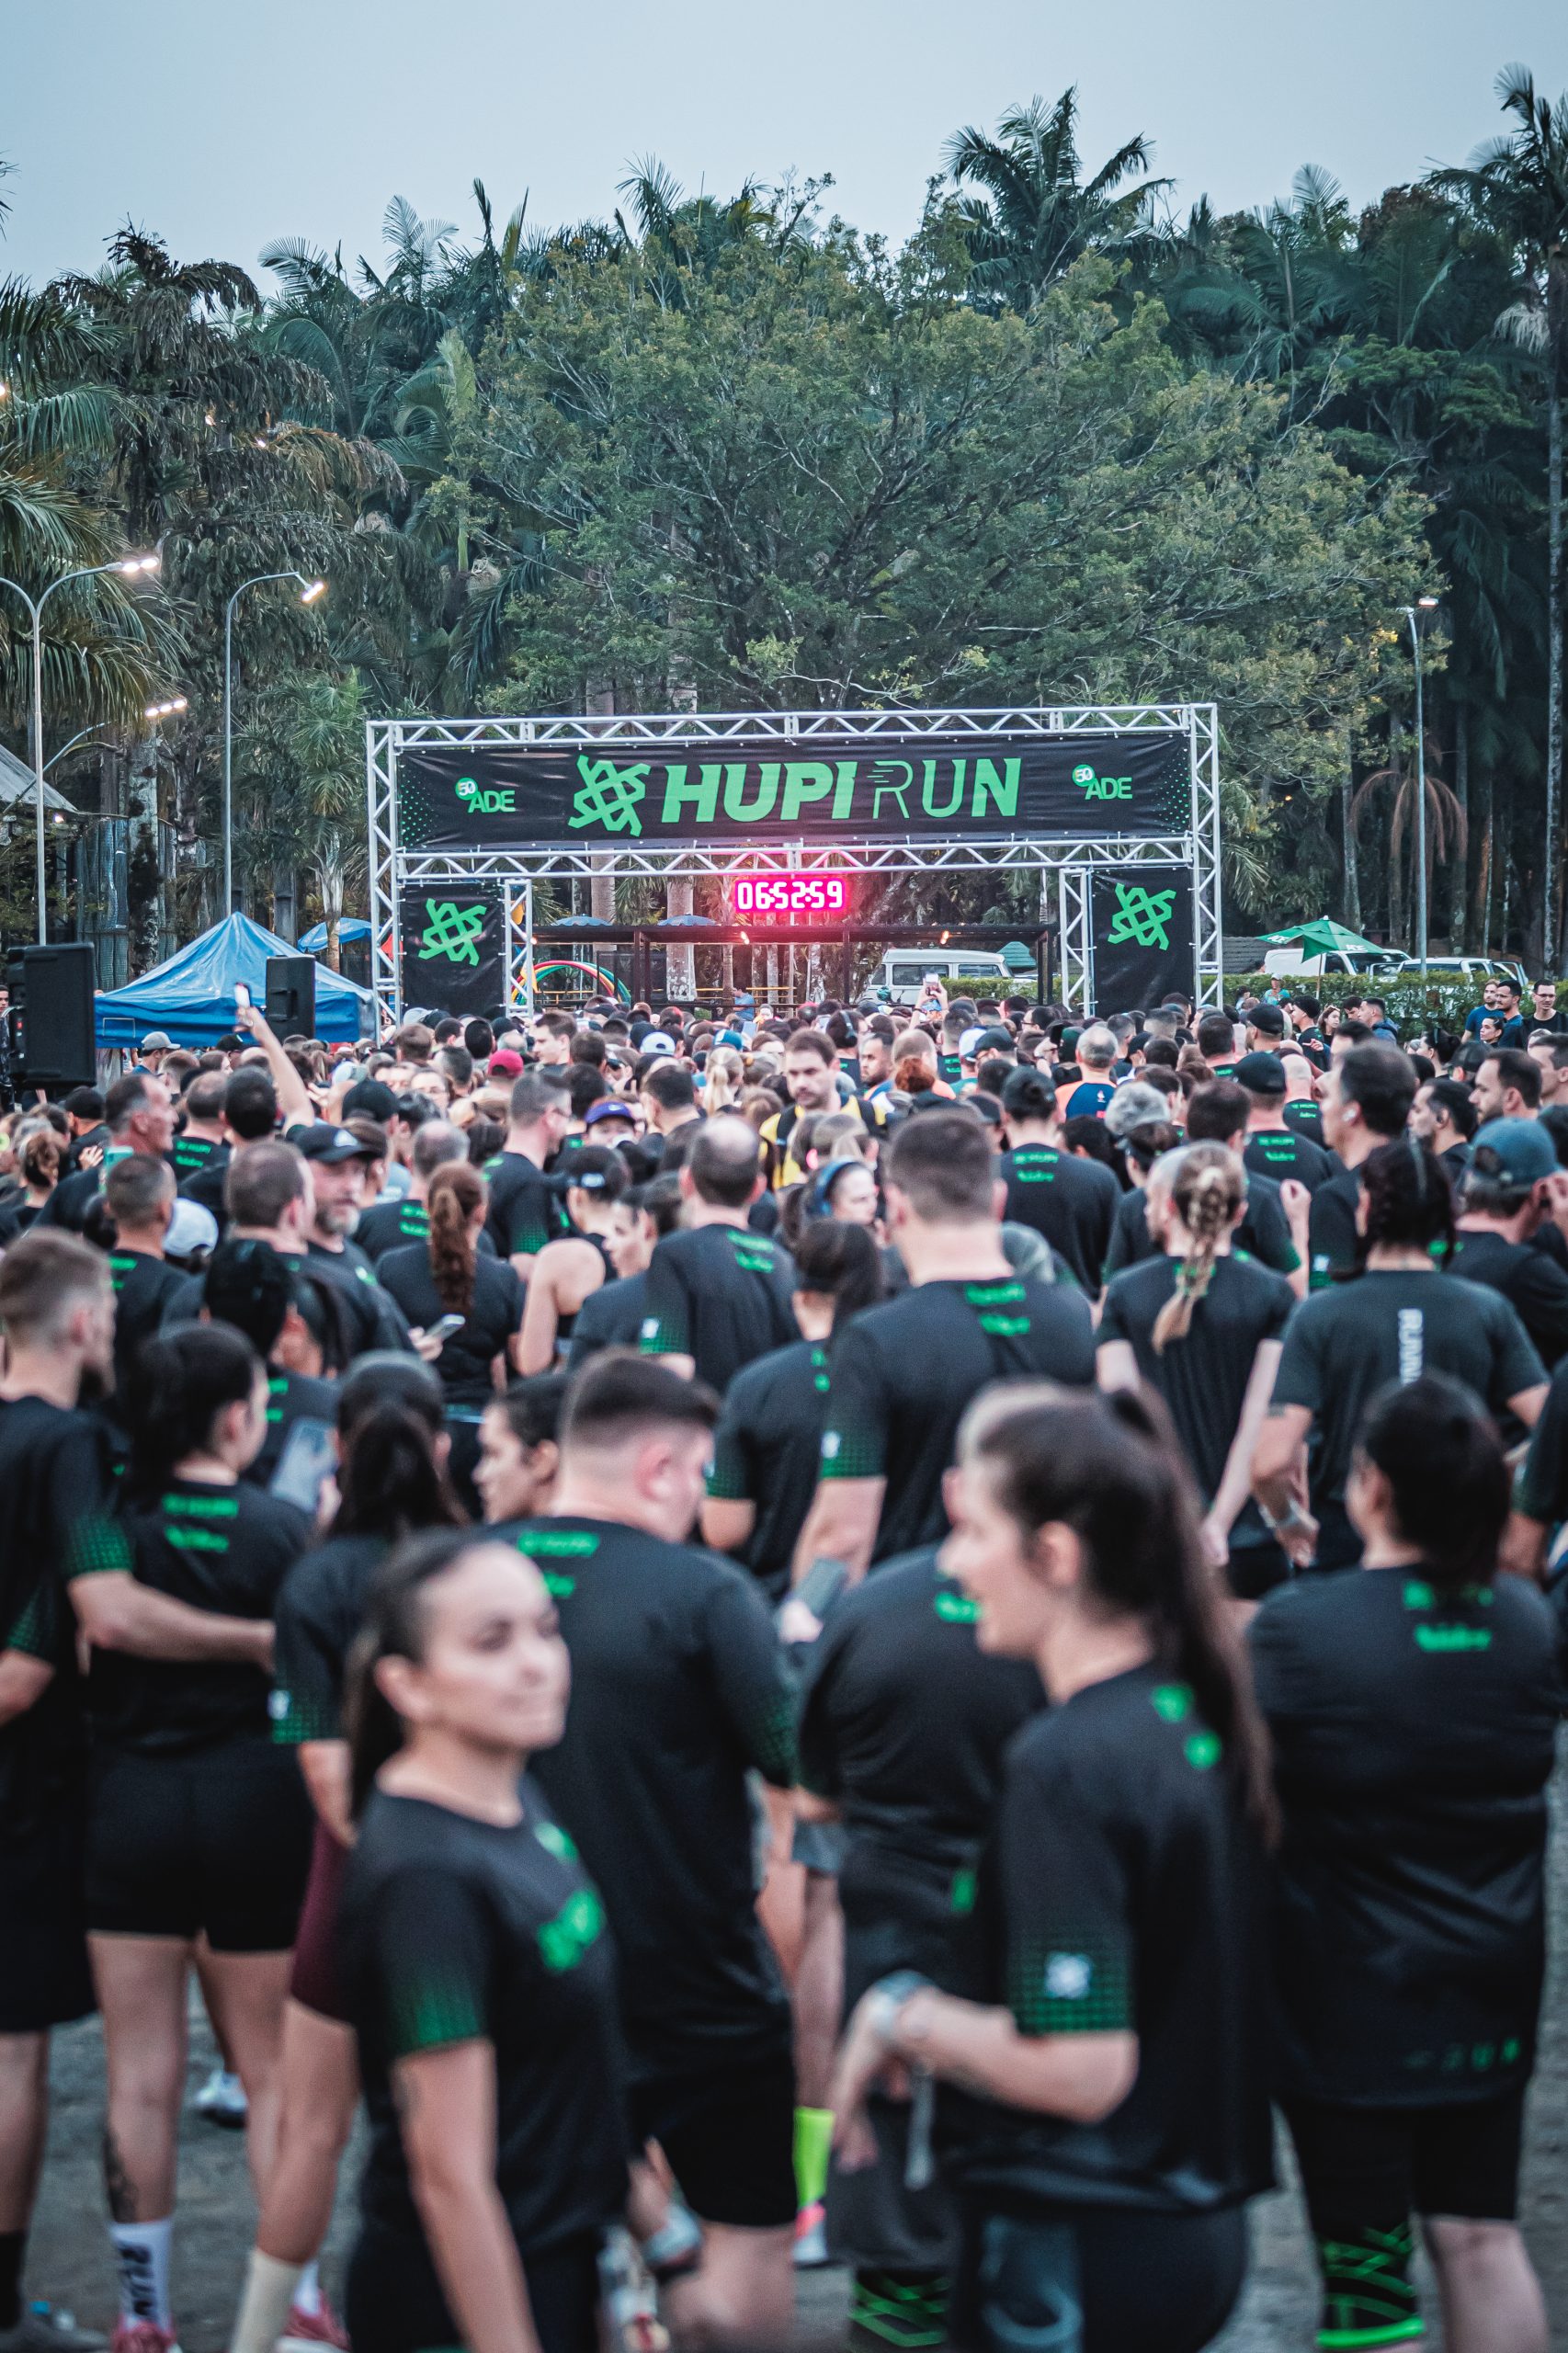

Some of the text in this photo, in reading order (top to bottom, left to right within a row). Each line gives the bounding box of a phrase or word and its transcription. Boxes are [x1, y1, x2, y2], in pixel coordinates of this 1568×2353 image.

[1075, 767, 1094, 782] 50
[458, 780, 476, 796] 50
[661, 757, 1022, 823] HUPI RUN
[1085, 777, 1133, 800] ADE
[467, 790, 516, 813] ADE
[737, 881, 843, 909] 06:52:59
